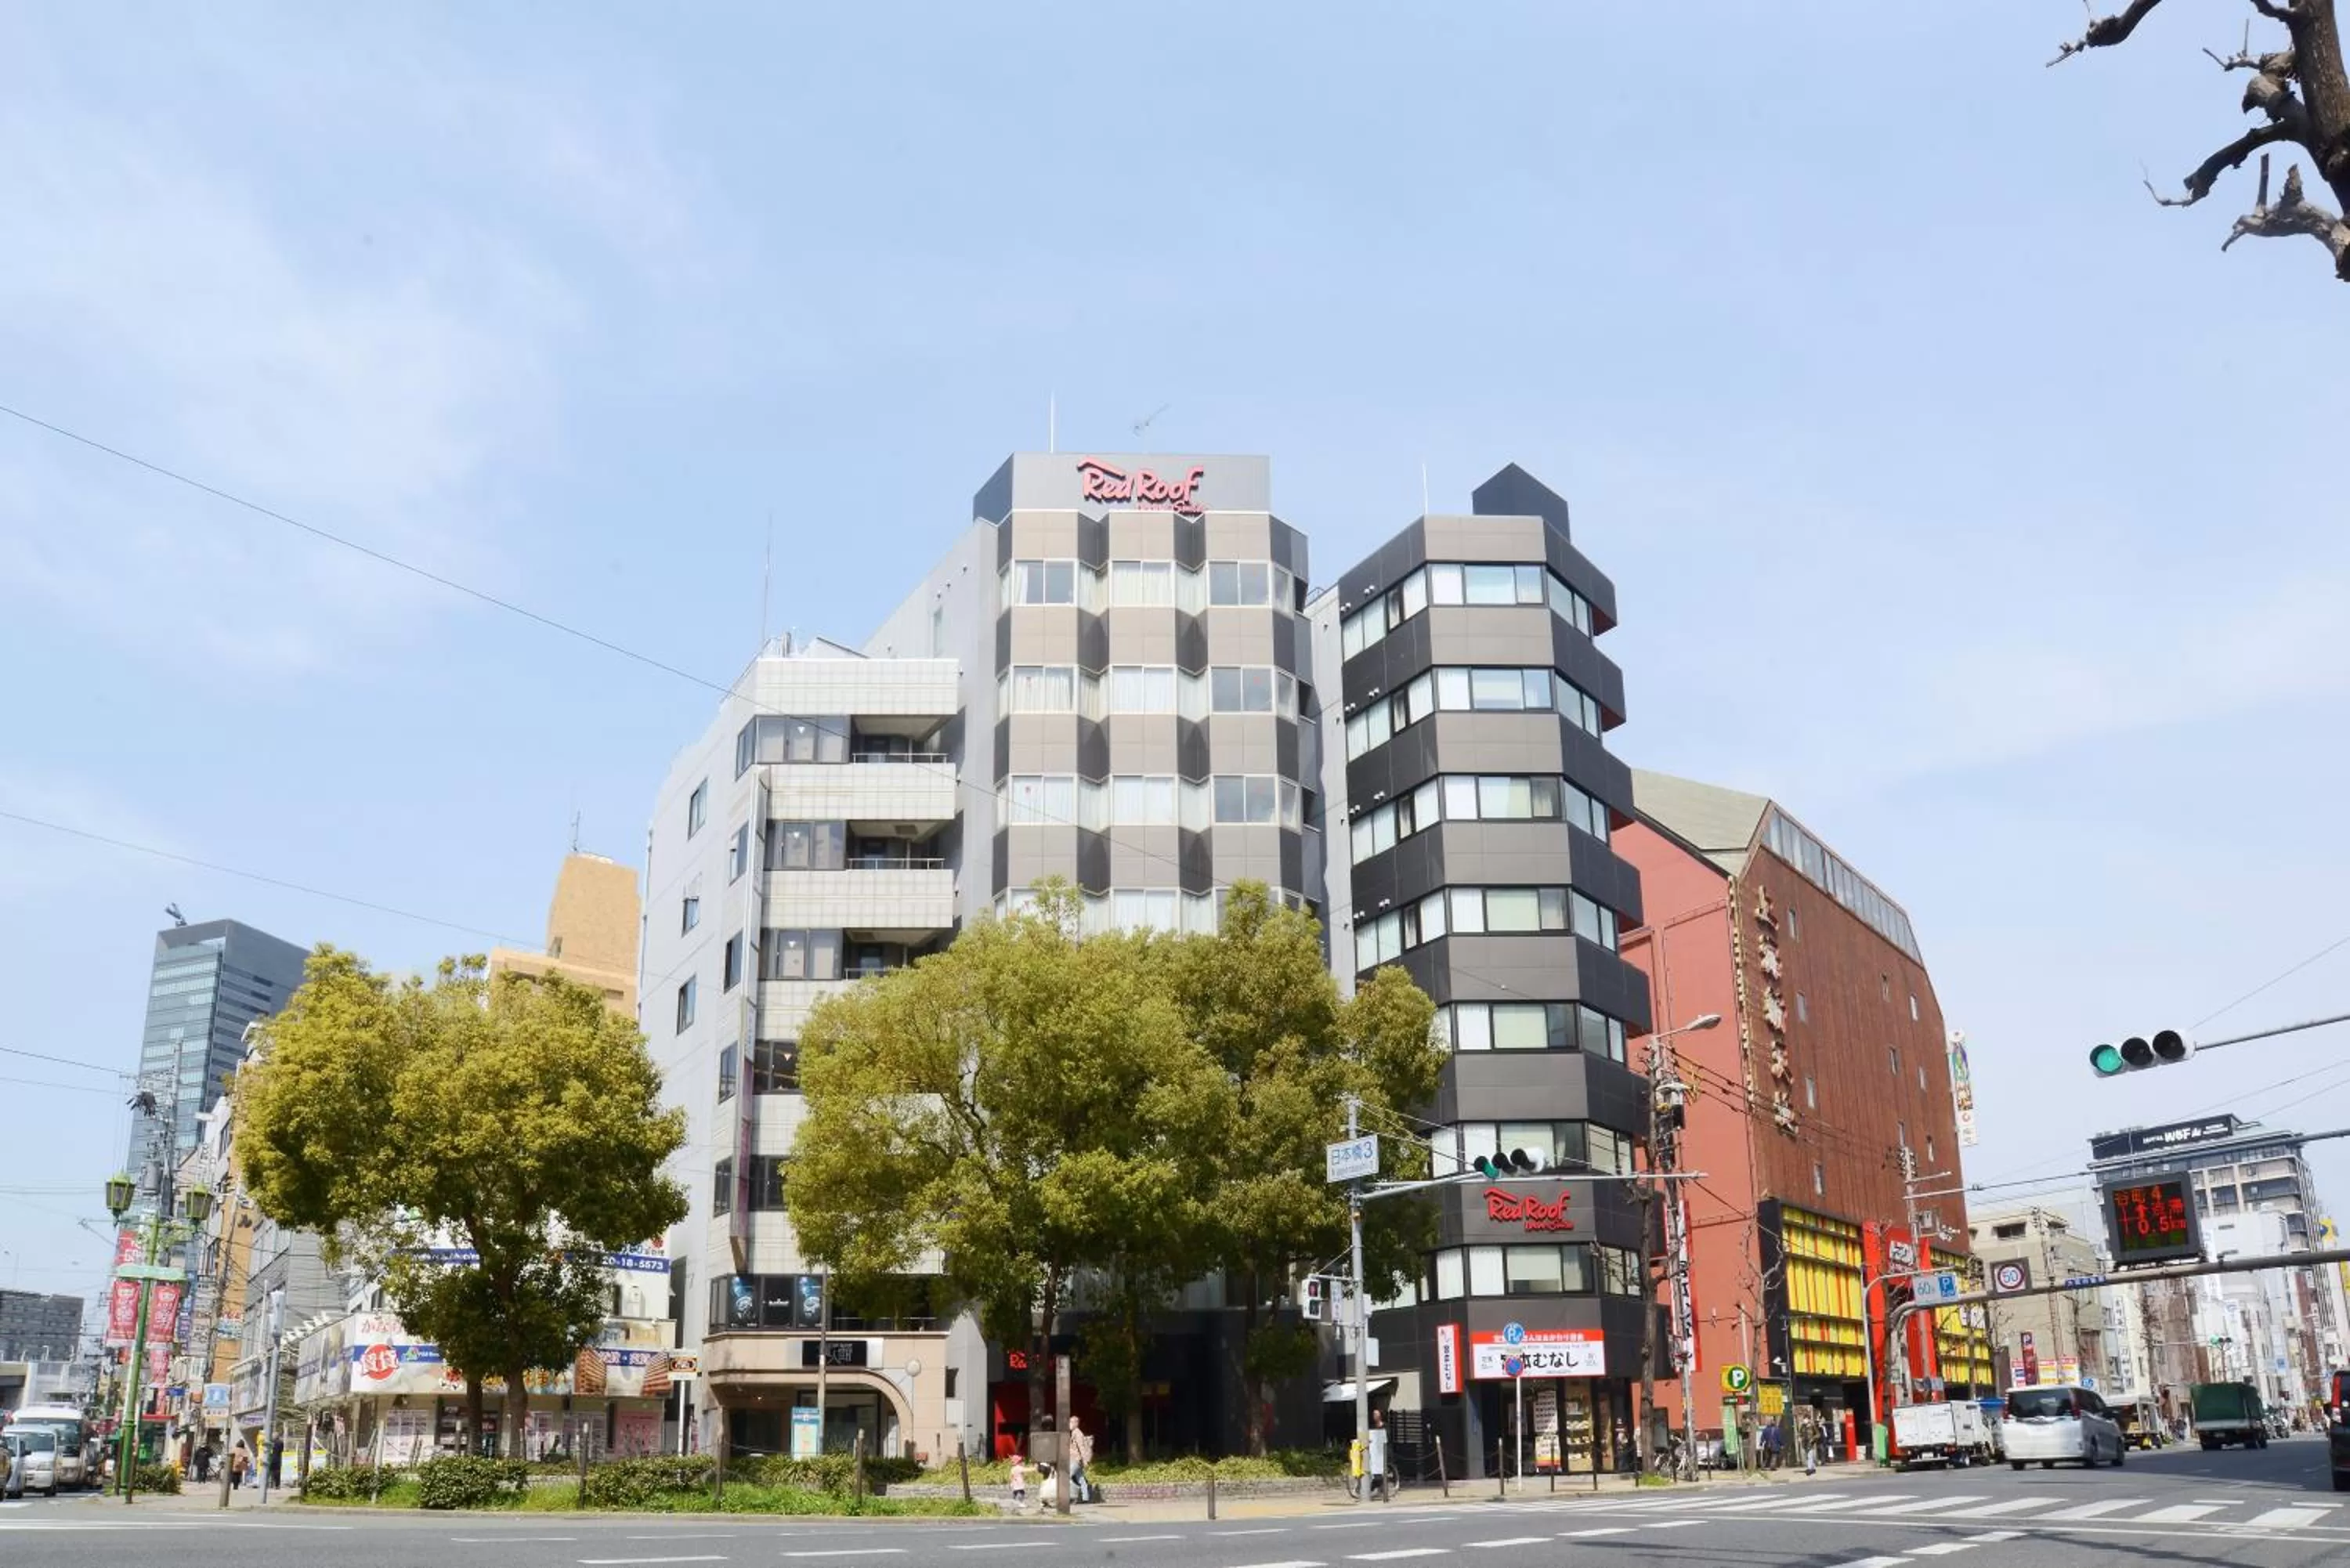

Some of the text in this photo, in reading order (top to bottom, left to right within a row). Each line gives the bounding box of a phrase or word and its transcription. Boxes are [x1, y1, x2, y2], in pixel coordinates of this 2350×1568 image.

[1081, 462, 1204, 504] Red Roof
[1332, 1140, 1373, 1165] 日本橋3
[1488, 1190, 1571, 1222] Red Roof
[2001, 1269, 2019, 1284] 50
[1501, 1351, 1578, 1371] 本むなし
[1731, 1368, 1744, 1387] P
